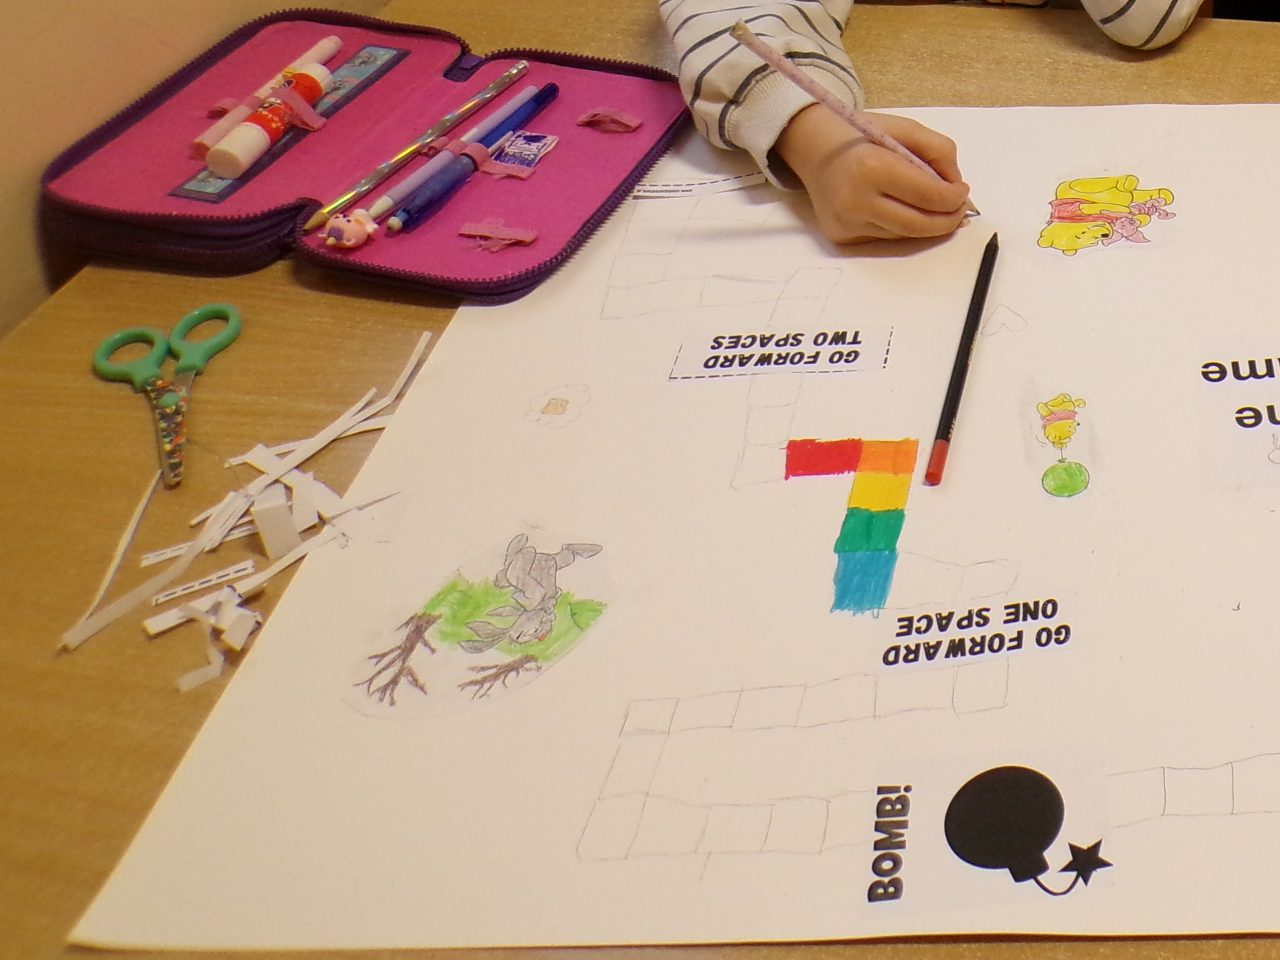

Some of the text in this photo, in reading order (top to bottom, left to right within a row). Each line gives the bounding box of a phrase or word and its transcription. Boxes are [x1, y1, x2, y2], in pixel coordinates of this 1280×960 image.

[704, 350, 859, 368] GO FORWARD
[711, 331, 861, 350] TWO SPACES
[895, 599, 1058, 637] ONE SPACE
[882, 624, 1071, 666] GO FORWARD
[867, 784, 913, 903] BOMB!
